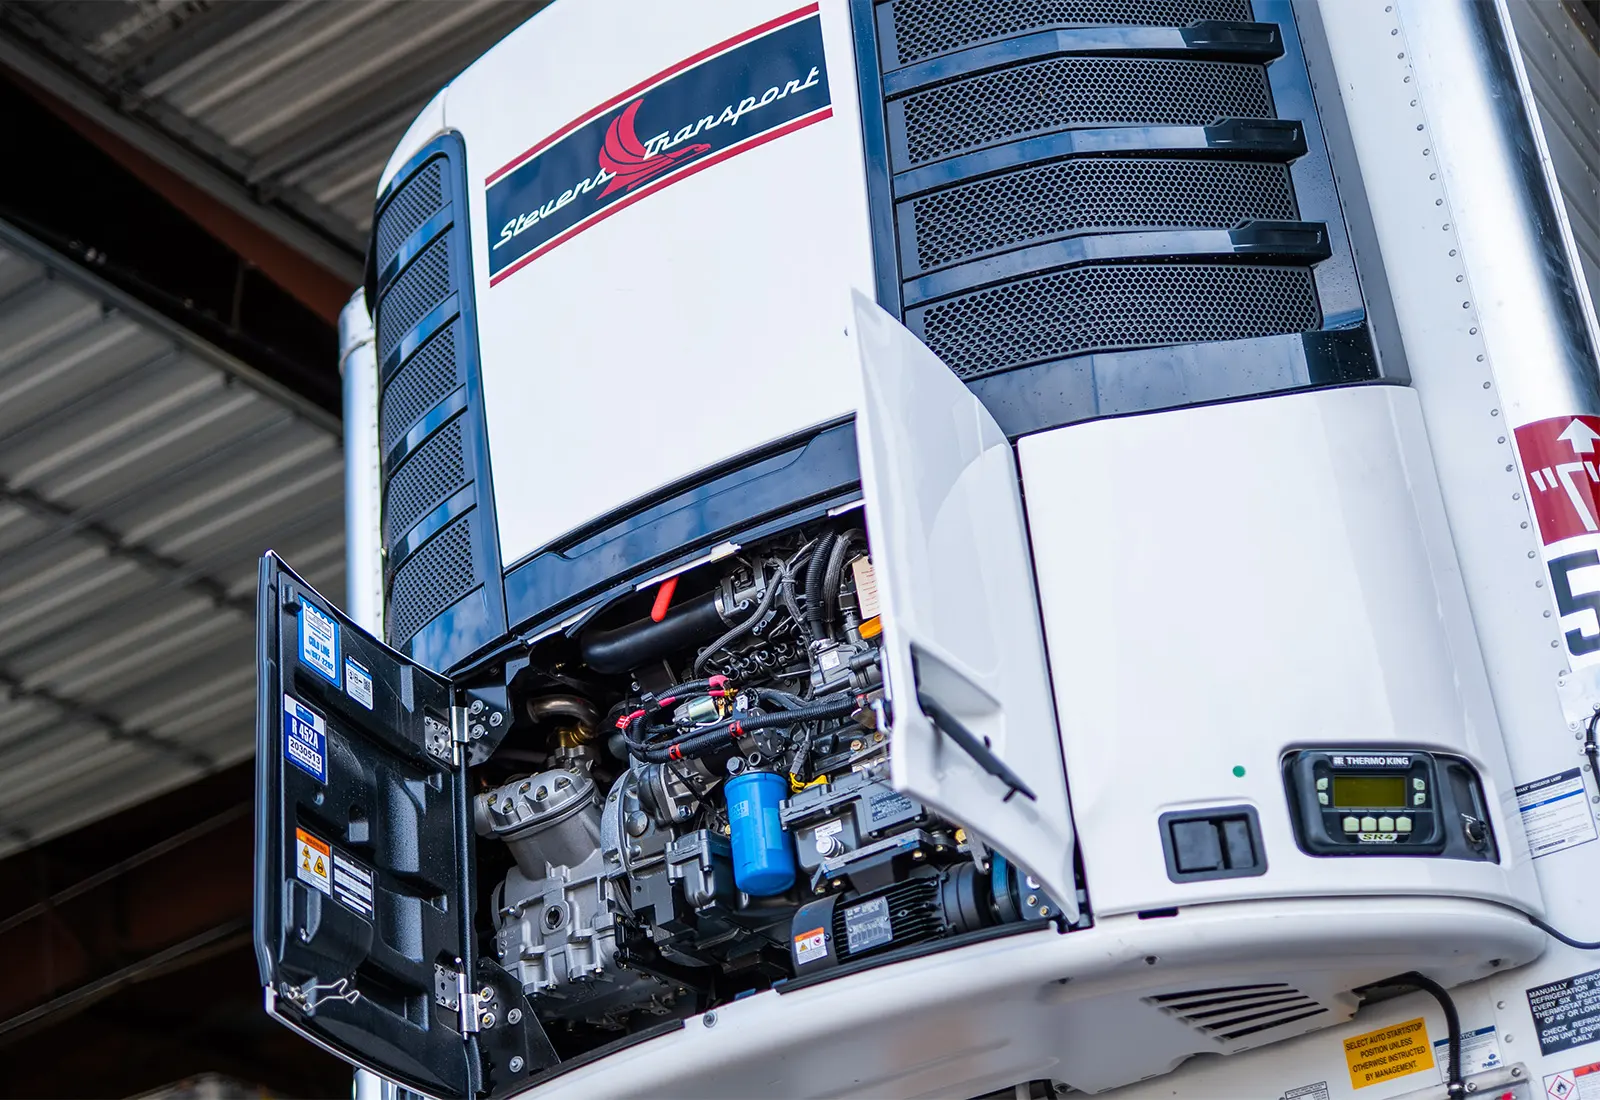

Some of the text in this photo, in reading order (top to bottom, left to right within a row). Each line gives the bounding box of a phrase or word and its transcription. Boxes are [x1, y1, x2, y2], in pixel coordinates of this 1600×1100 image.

[493, 66, 820, 250] Stevens Transport
[291, 717, 298, 735] R
[299, 723, 319, 749] 452A
[290, 739, 321, 765] 2030513
[1345, 756, 1386, 765] THERMO
[1386, 756, 1409, 765] KING
[1529, 972, 1600, 998] MANUALLY DEFRO
[1531, 984, 1588, 1005] REFRIGERATION
[1532, 1000, 1557, 1012] EVERY
[1559, 996, 1571, 1005] SIX
[1535, 1000, 1582, 1019] THERMOSTAT
[1544, 1016, 1555, 1024] OF
[1567, 1009, 1579, 1017] OR
[1345, 1022, 1423, 1051] SELECT AUTO START/STOP
[1542, 1024, 1568, 1037] CHECK
[1542, 1035, 1559, 1045] TION
[1560, 1029, 1577, 1040] UNIT
[1571, 1033, 1595, 1044] DAILY.
[1360, 1037, 1413, 1058] POSITION UNLESS
[1353, 1046, 1426, 1072] OTHERWISE INSTRUCTED
[1365, 1073, 1374, 1081] BY
